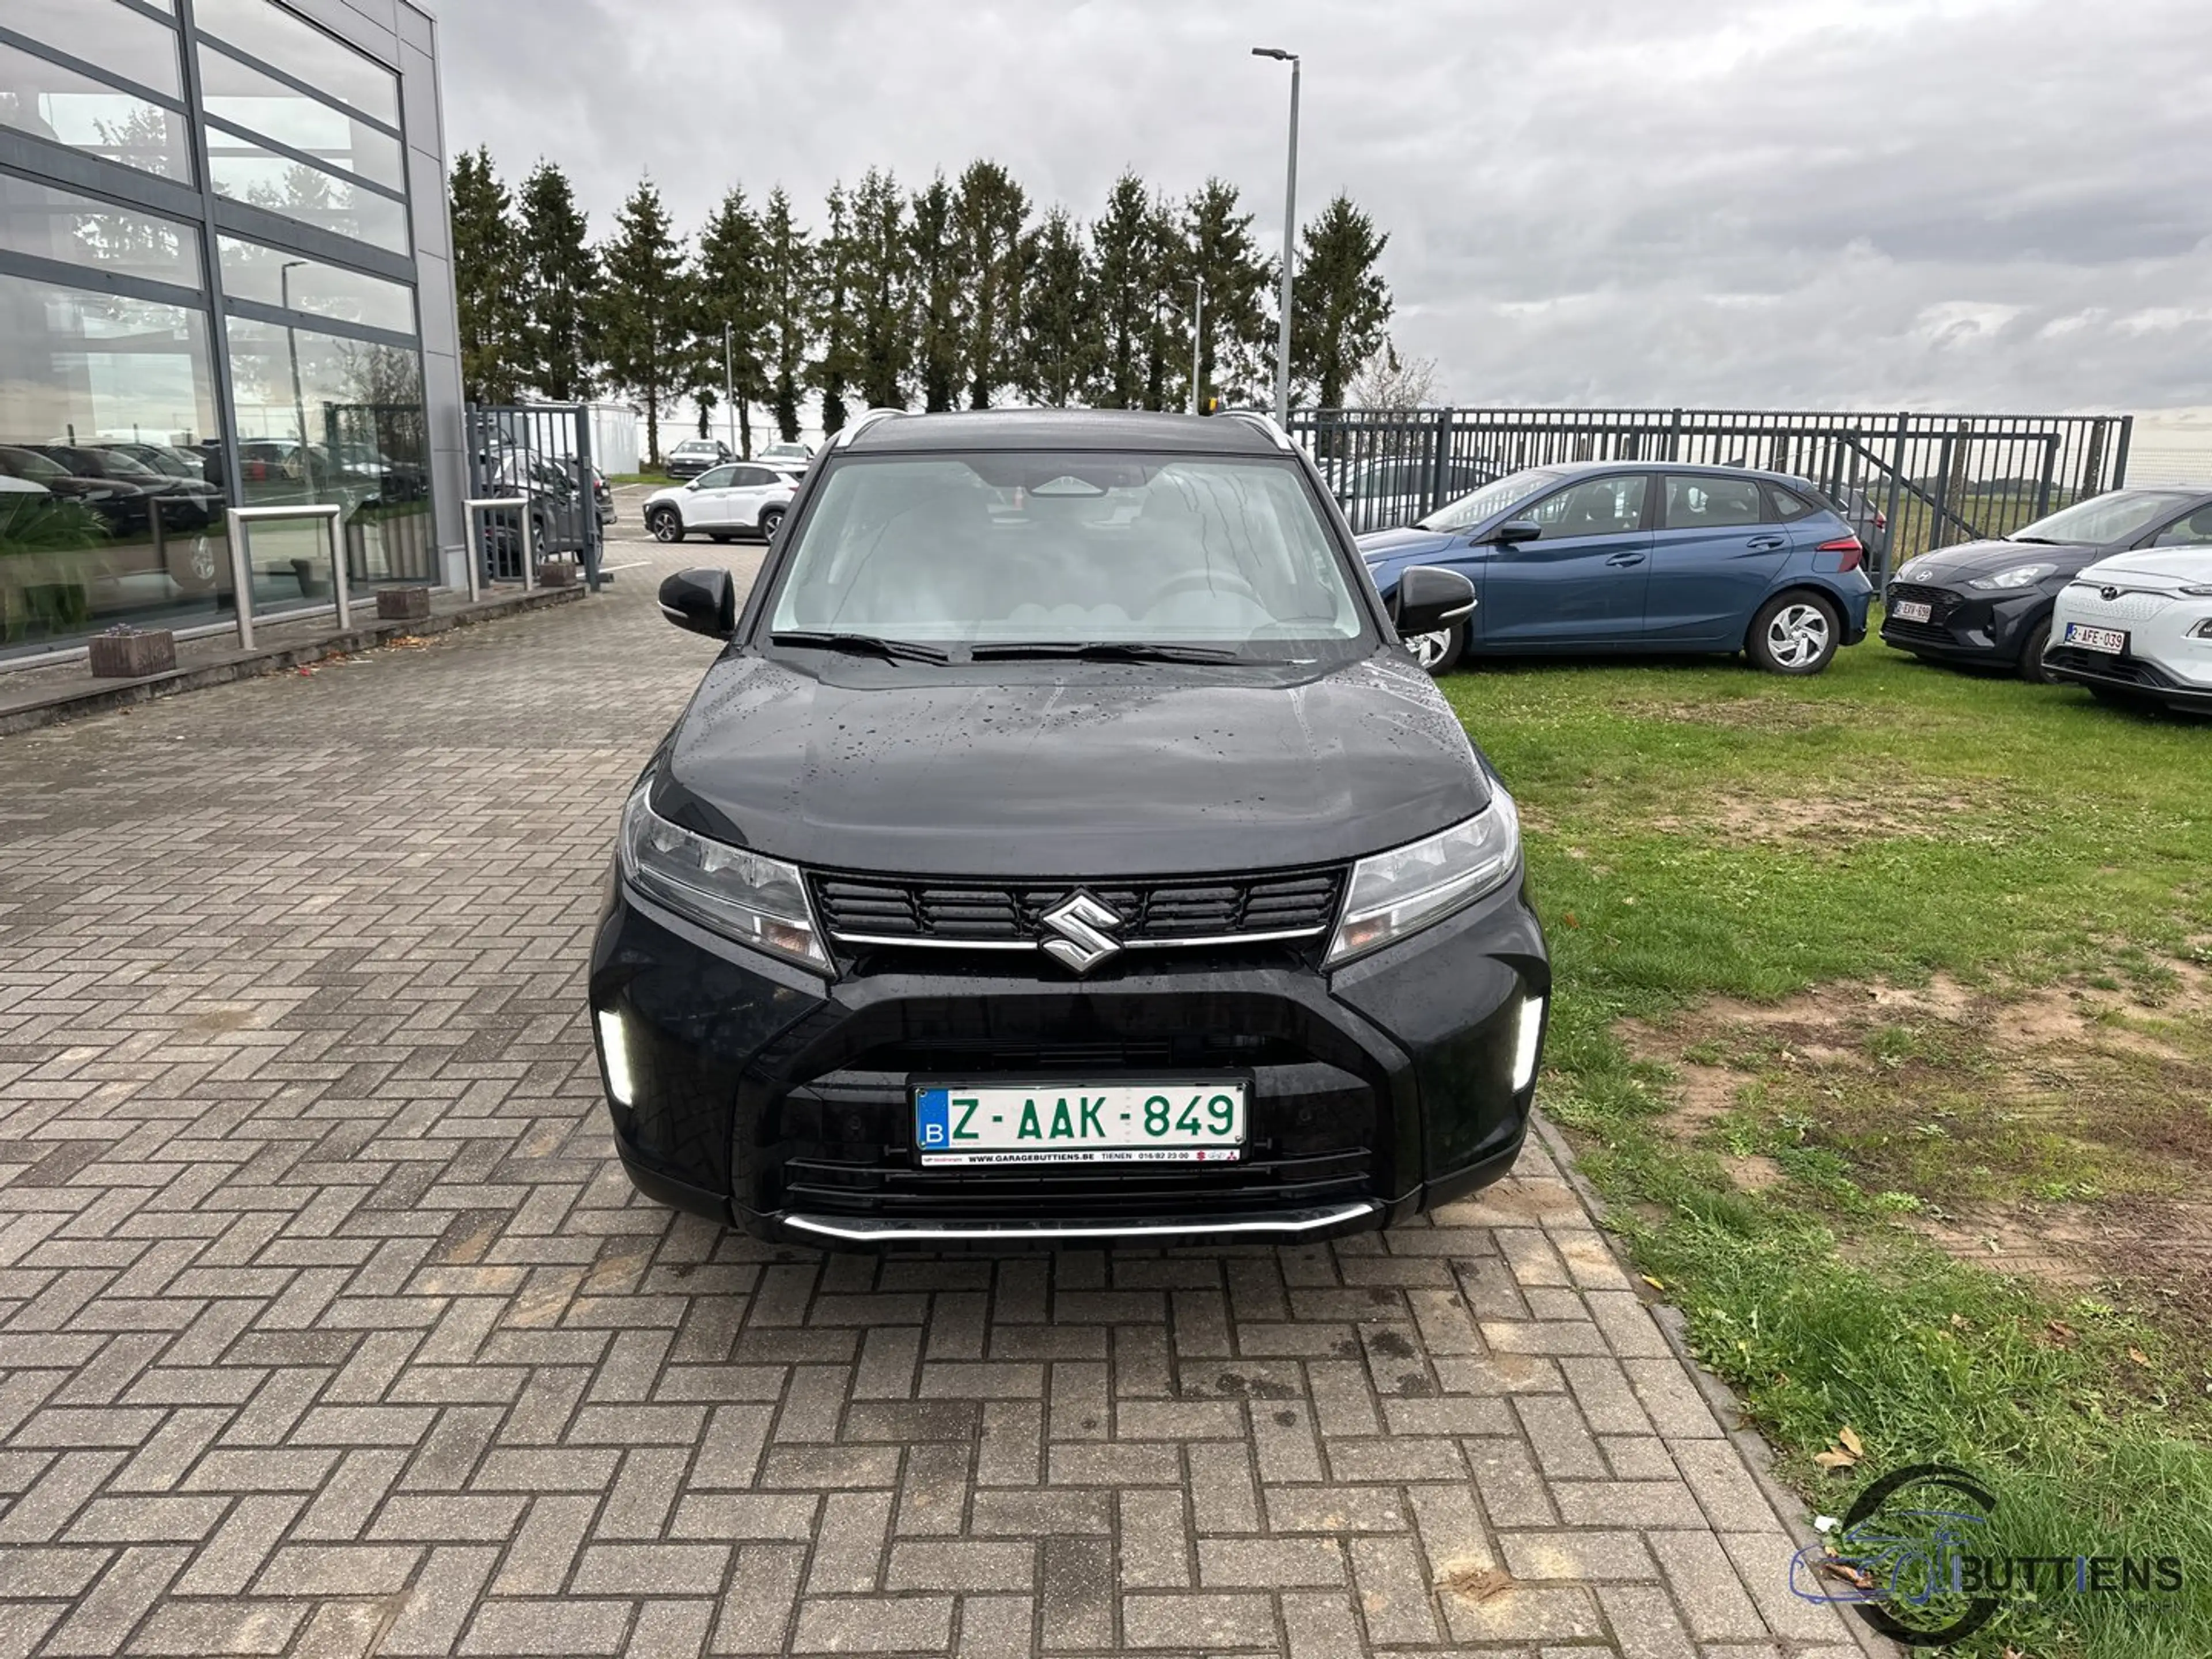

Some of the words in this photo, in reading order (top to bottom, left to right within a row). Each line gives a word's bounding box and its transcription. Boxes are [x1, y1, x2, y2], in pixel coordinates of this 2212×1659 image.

[2070, 626, 2122, 647] 2-AFE-039
[926, 1124, 944, 1143] B
[968, 1153, 1094, 1163] WWW.GARAGEBUTTIENS.BE
